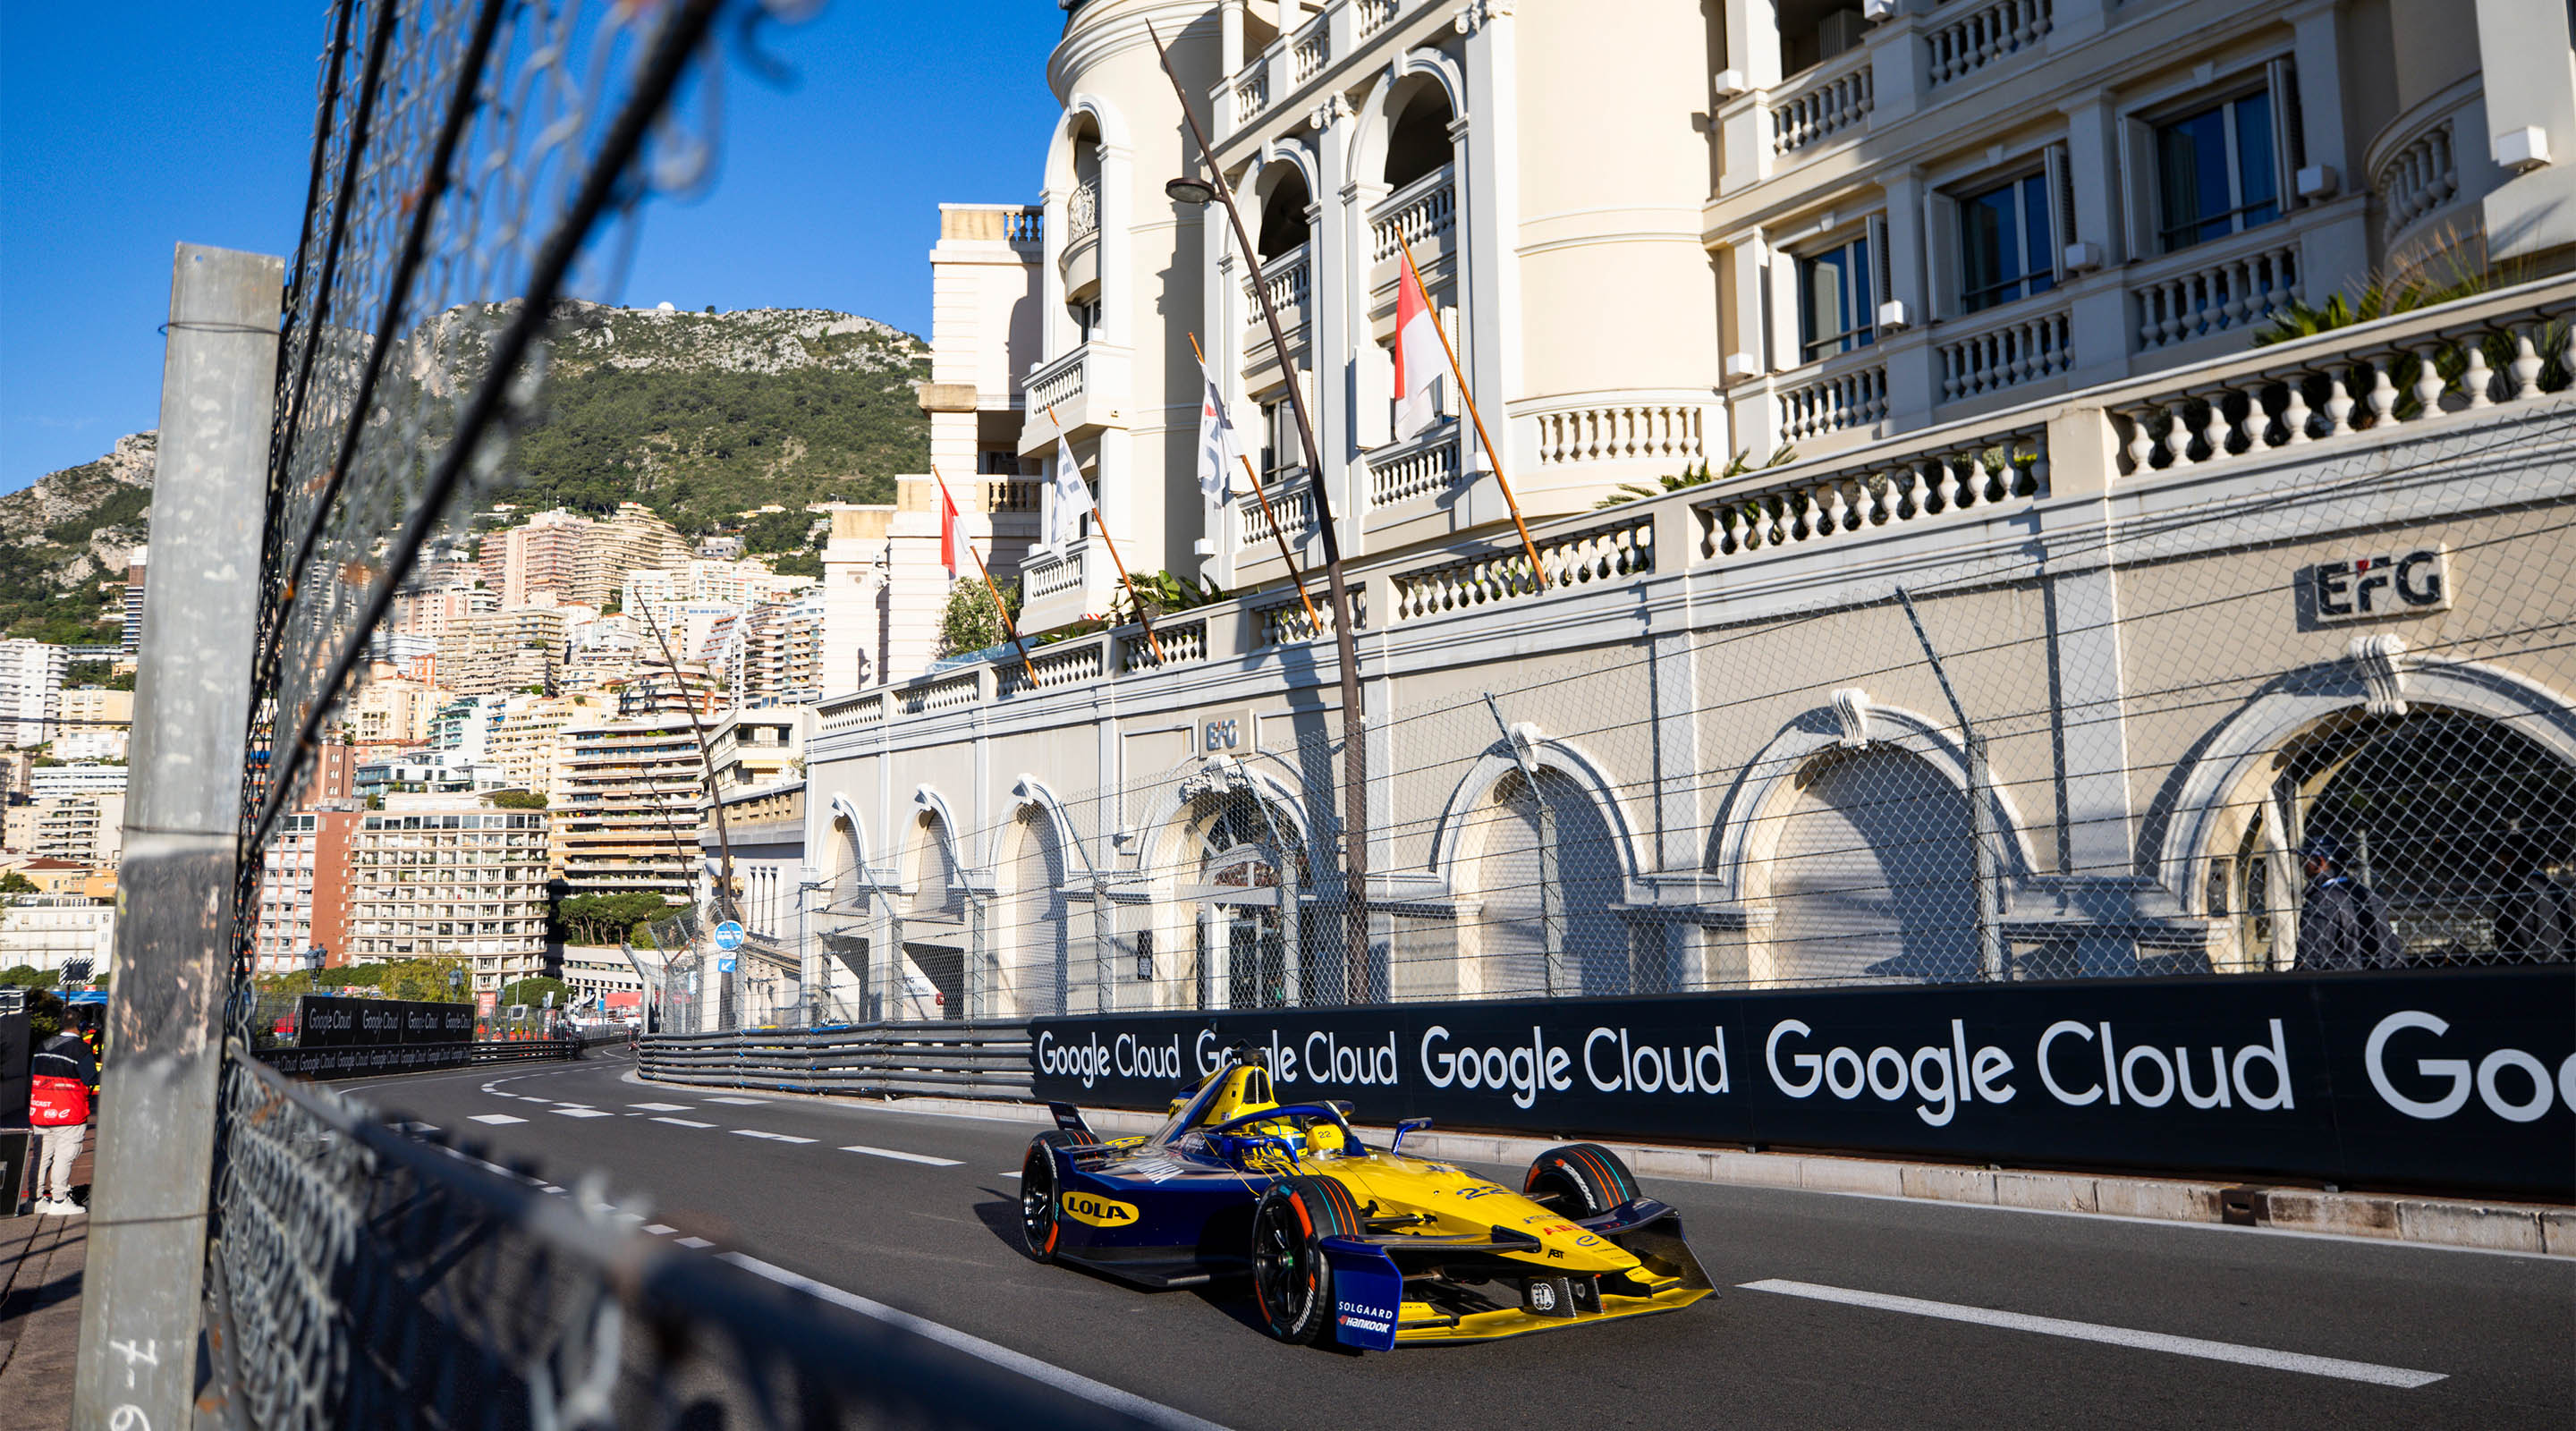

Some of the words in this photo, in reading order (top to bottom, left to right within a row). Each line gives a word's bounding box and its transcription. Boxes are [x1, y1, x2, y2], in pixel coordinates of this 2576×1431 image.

[2317, 550, 2441, 615] EFG
[1207, 719, 1238, 751] EFG
[1038, 1030, 1111, 1088] Google
[1115, 1033, 1181, 1079] Cloud
[1196, 1029, 1298, 1089] Gole
[1305, 1030, 1398, 1085] Cloud
[1420, 1025, 1572, 1109] Google
[1583, 1025, 1730, 1093] Cloud
[1766, 1019, 2017, 1126] Google
[2038, 1018, 2296, 1111] Cloud
[2365, 1010, 2576, 1122] Go
[1318, 1130, 1332, 1139] 22
[1068, 1197, 1131, 1220] LOLA
[1547, 1249, 1564, 1259] ABT
[1338, 1301, 1393, 1319] SOLGAARD
